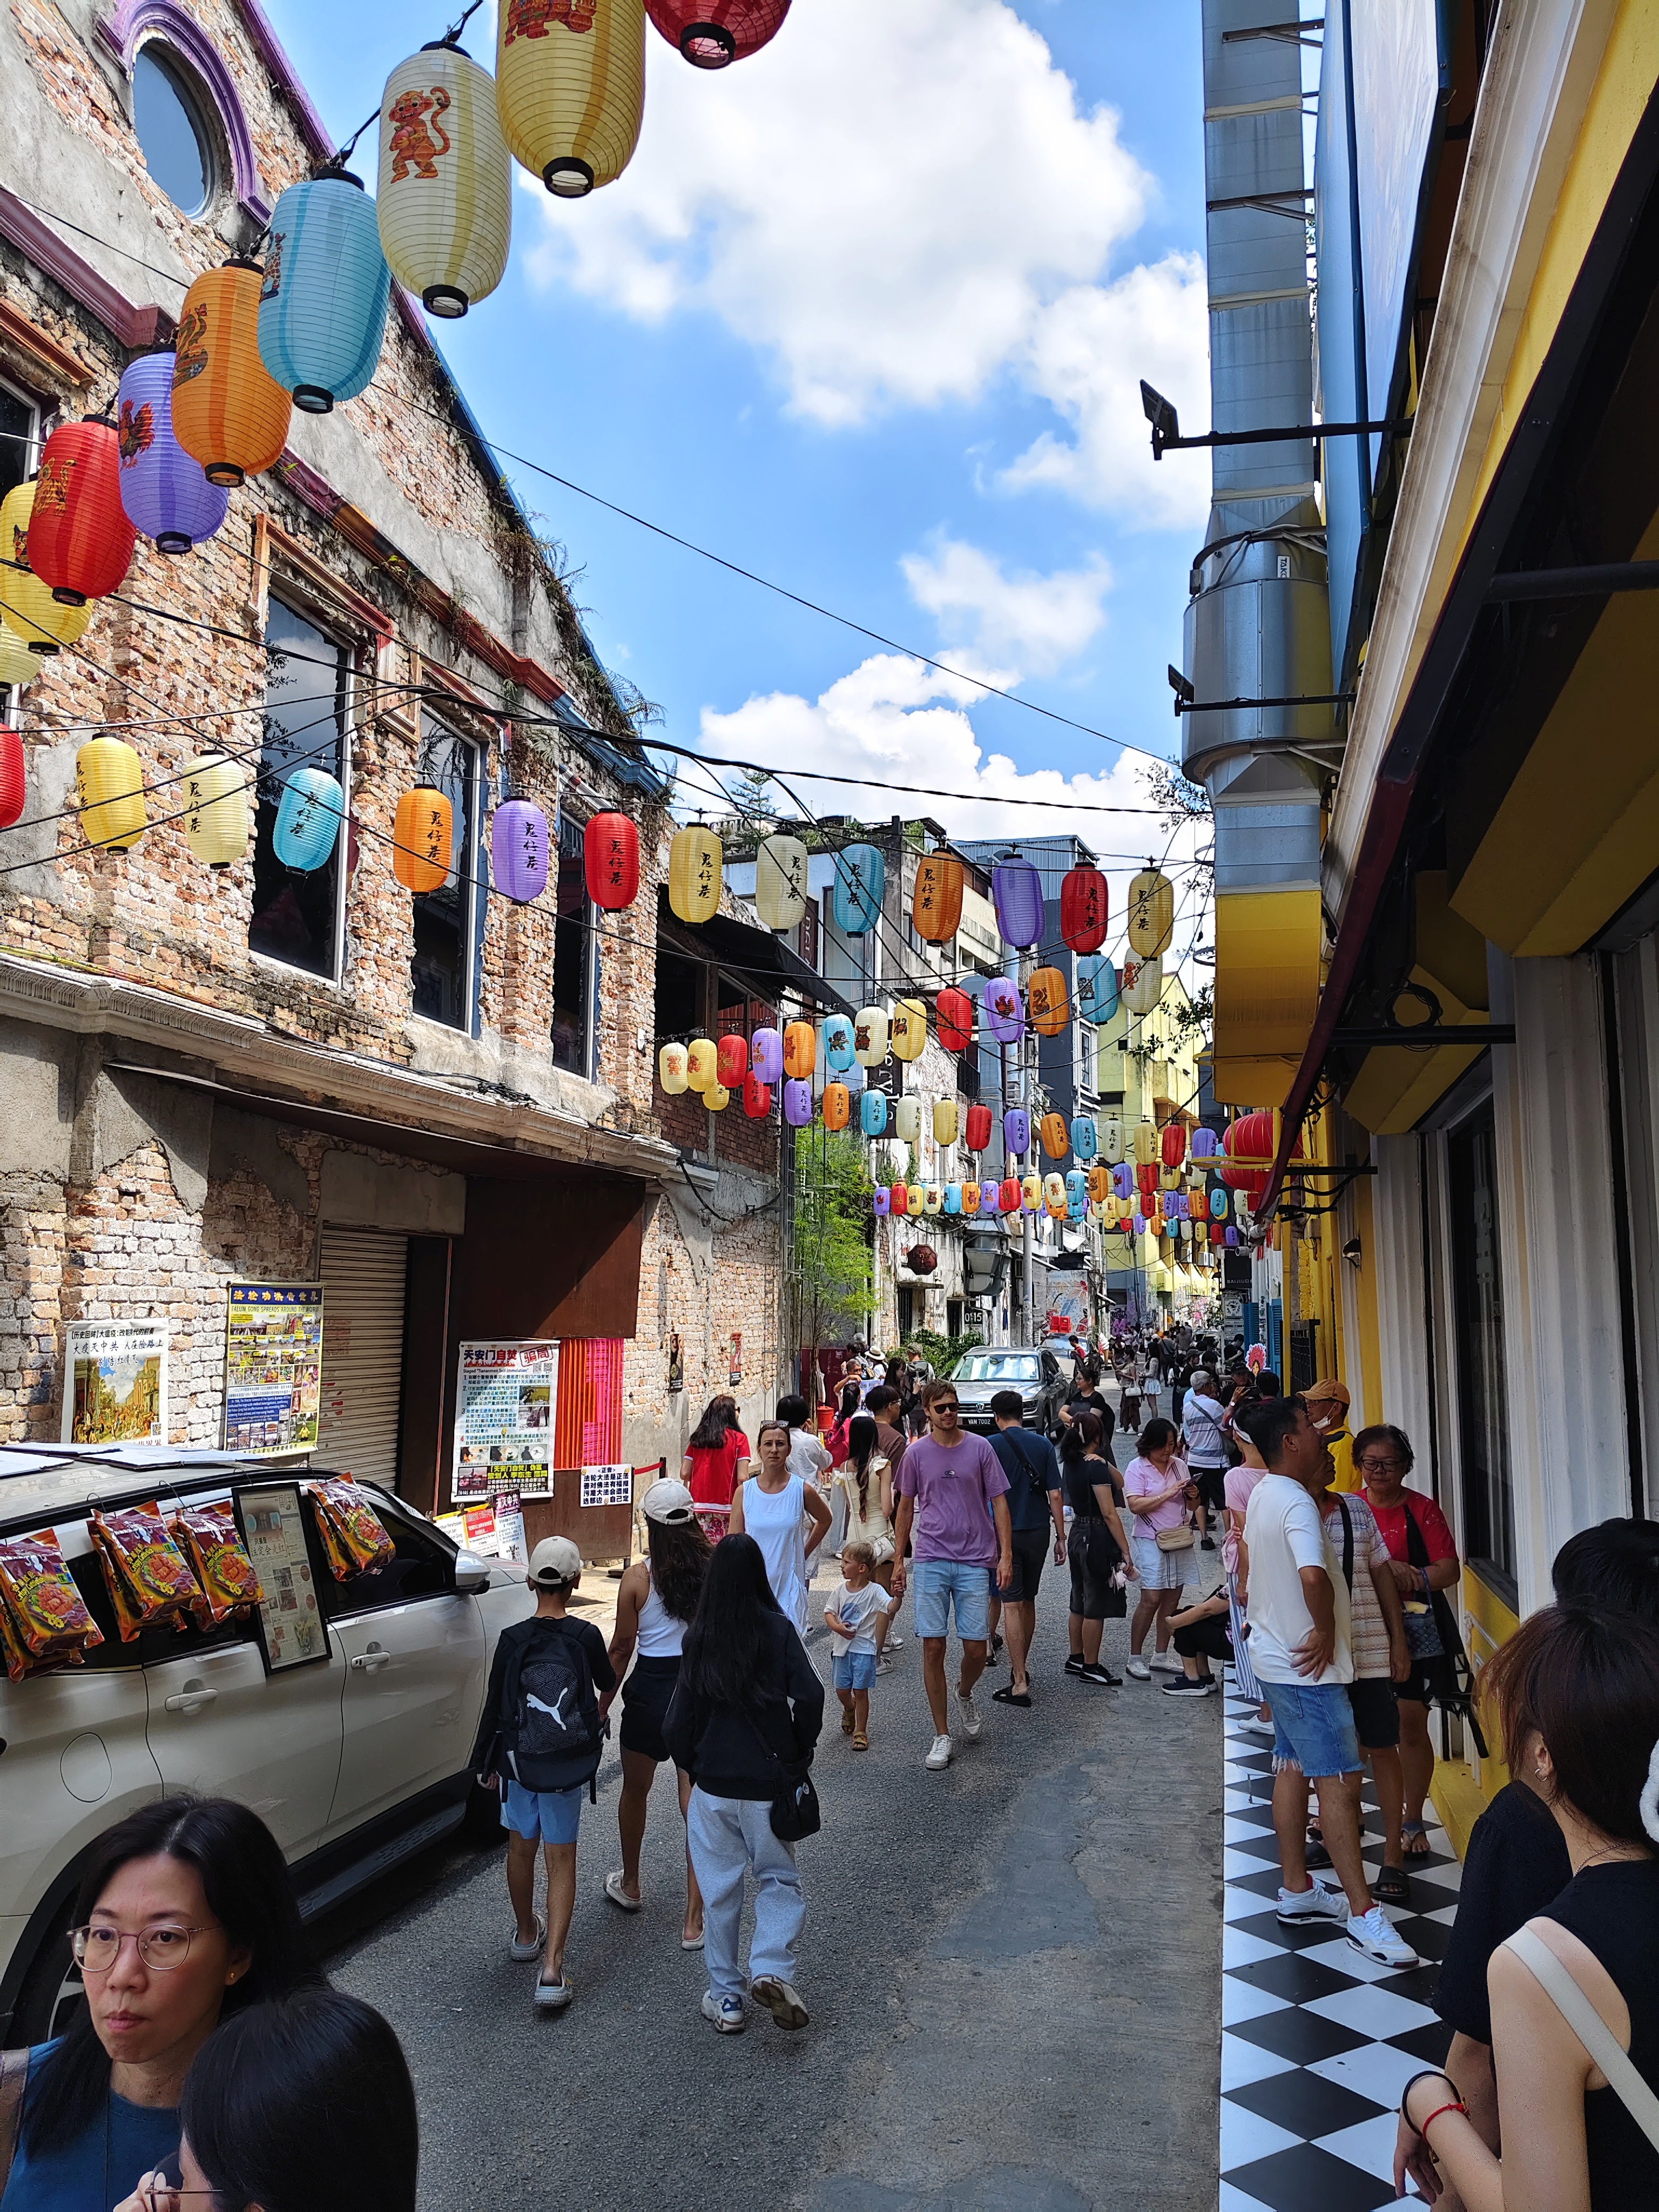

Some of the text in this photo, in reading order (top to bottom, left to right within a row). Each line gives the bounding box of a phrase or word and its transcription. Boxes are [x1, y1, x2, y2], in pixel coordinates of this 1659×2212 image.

[425, 811, 443, 860] 鬼仔巷
[523, 822, 539, 871] 鬼仔巷
[608, 840, 625, 886] 鬼仔巷
[697, 852, 713, 898] 鬼仔巷
[787, 855, 802, 901] 鬼仔巷
[921, 868, 935, 910] 鬼仔巷
[1084, 887, 1100, 928] 鬼仔巷
[463, 1346, 550, 1364] 天安门自焚 骗局
[584, 1473, 629, 1481] 法轮大法是正法
[610, 1495, 629, 1503] 自己定
